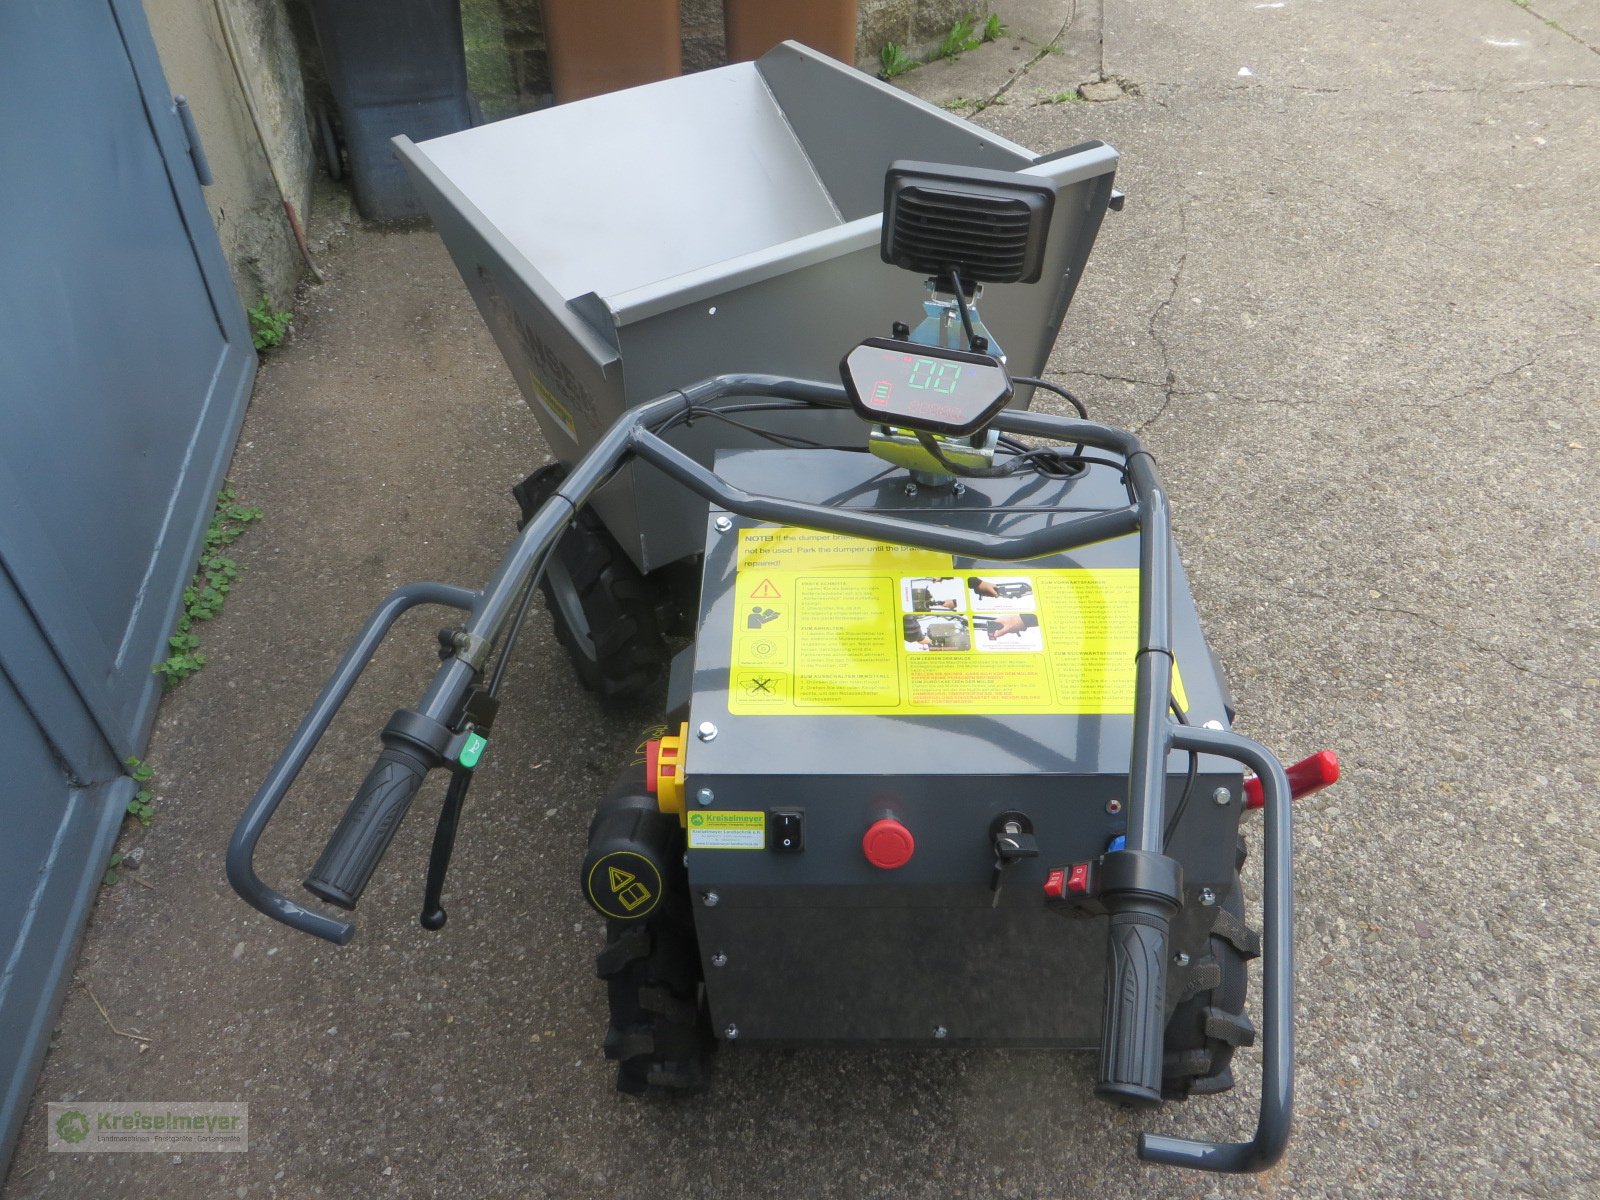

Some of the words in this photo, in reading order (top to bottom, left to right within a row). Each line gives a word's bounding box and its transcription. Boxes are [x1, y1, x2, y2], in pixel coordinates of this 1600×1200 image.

[798, 534, 831, 542] dumper
[833, 545, 865, 553] dumper
[886, 544, 899, 552] the
[744, 560, 781, 568] repaired!
[707, 814, 764, 823] Kreiselmeyer
